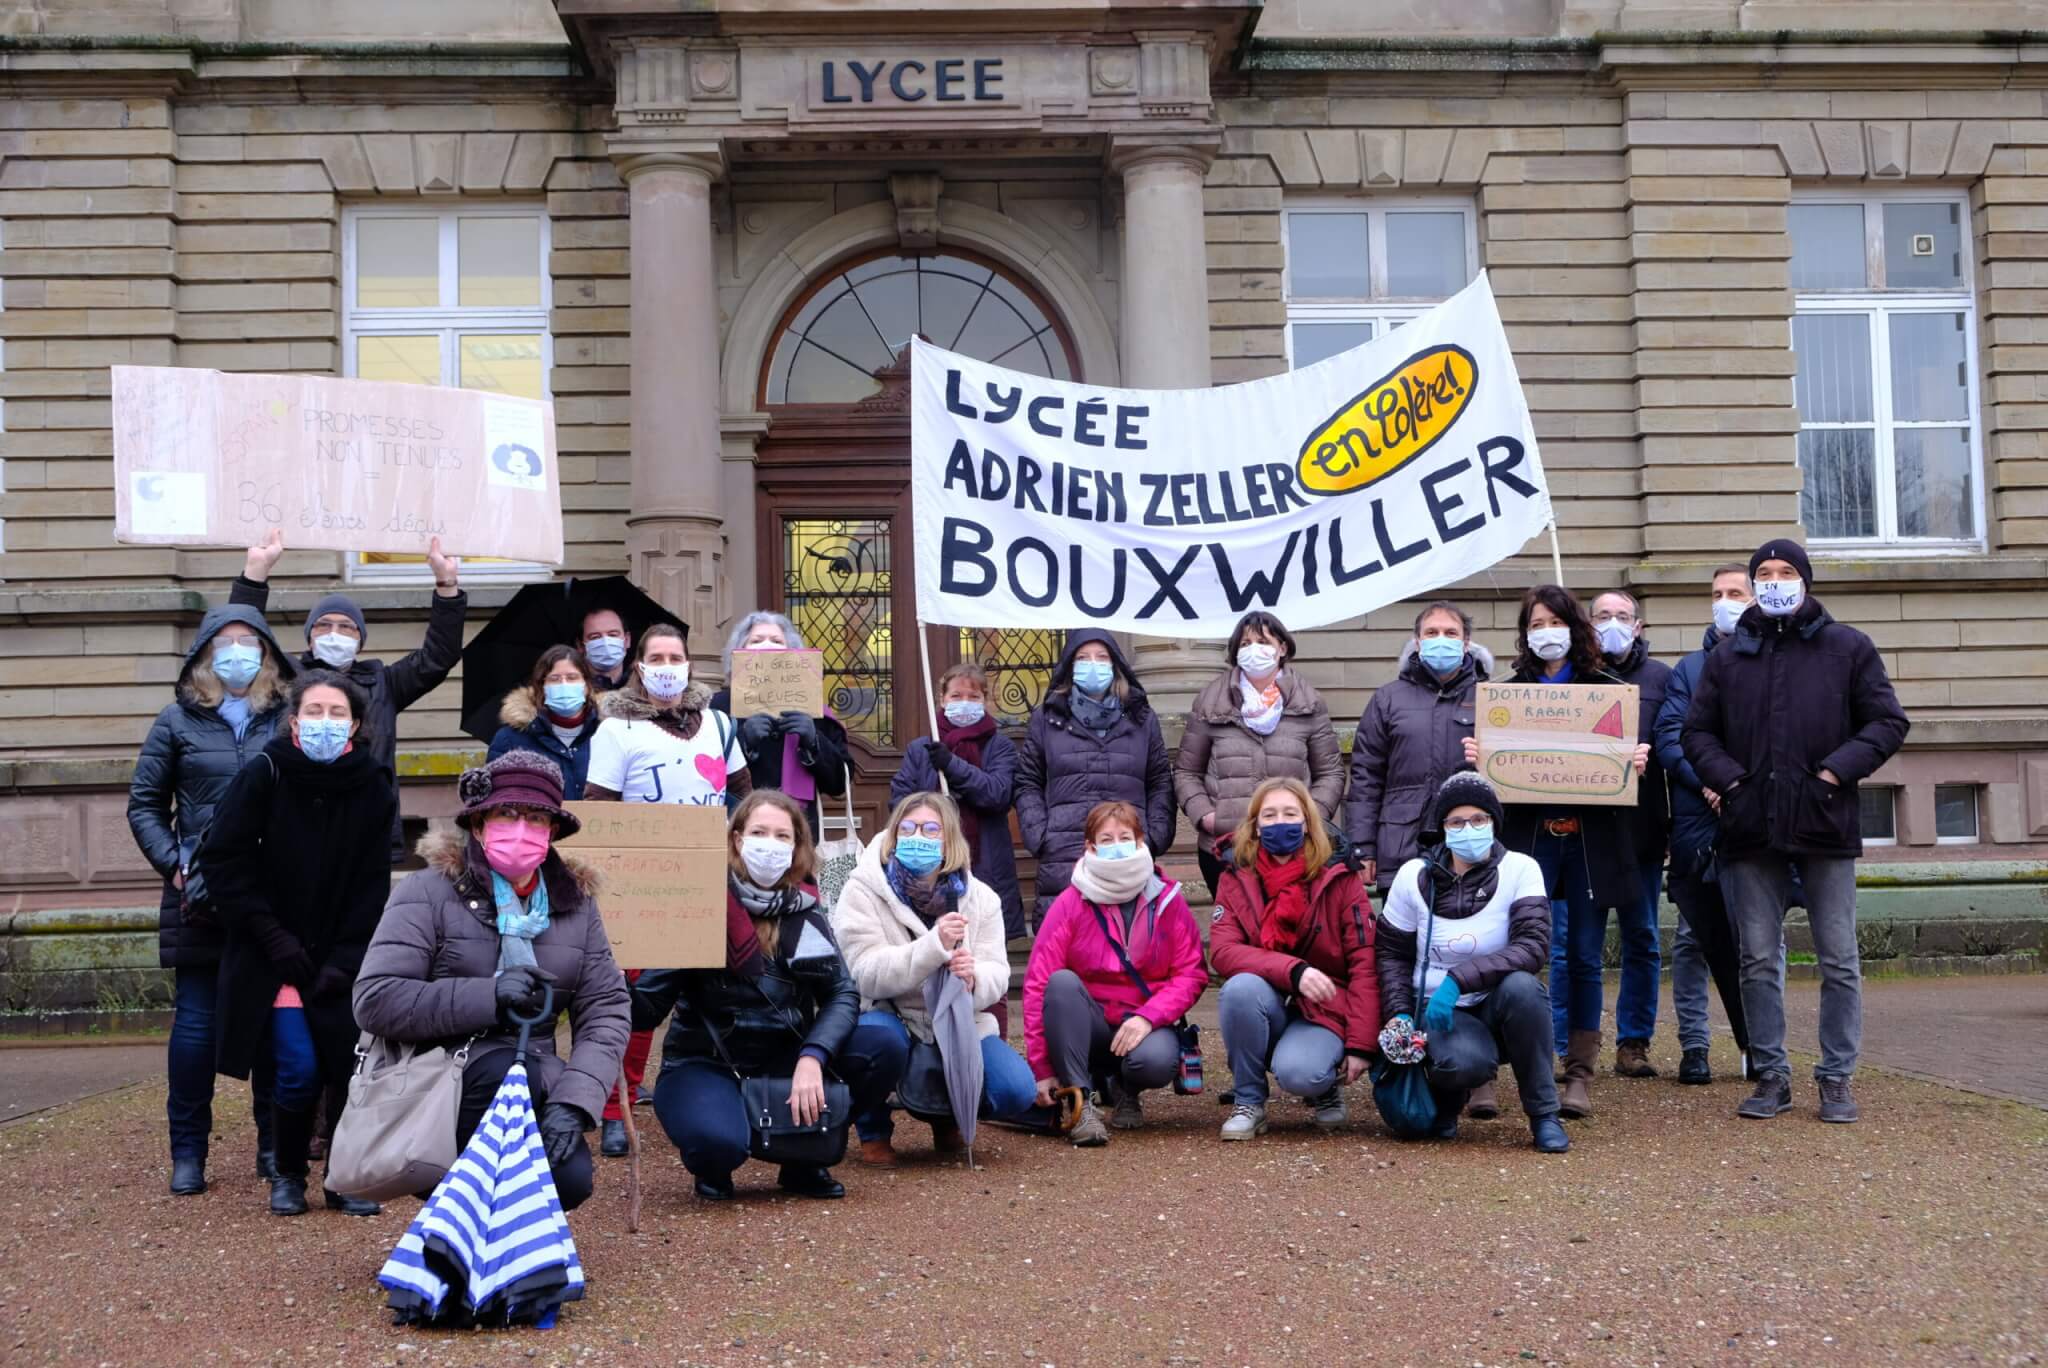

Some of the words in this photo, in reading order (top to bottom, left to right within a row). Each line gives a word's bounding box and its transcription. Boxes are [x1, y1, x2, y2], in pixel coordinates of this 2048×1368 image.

[821, 58, 1004, 103] LYCEE
[303, 408, 444, 441] PROMESSES
[945, 369, 1149, 450] LYCÉE
[316, 439, 361, 462] NON
[378, 441, 463, 469] TENUES
[1311, 427, 1381, 477] en
[943, 438, 1128, 523] ADRIEN
[1140, 462, 1312, 527] ZELLER
[238, 480, 282, 524] 36
[939, 435, 1540, 620] BOUXWILLER
[1488, 687, 1571, 701] DOTATION
[1586, 690, 1606, 702] AU
[1524, 706, 1583, 718] RABAIS
[1495, 753, 1565, 767] OPTIONS
[1528, 770, 1620, 785] SACRIFIÉES
